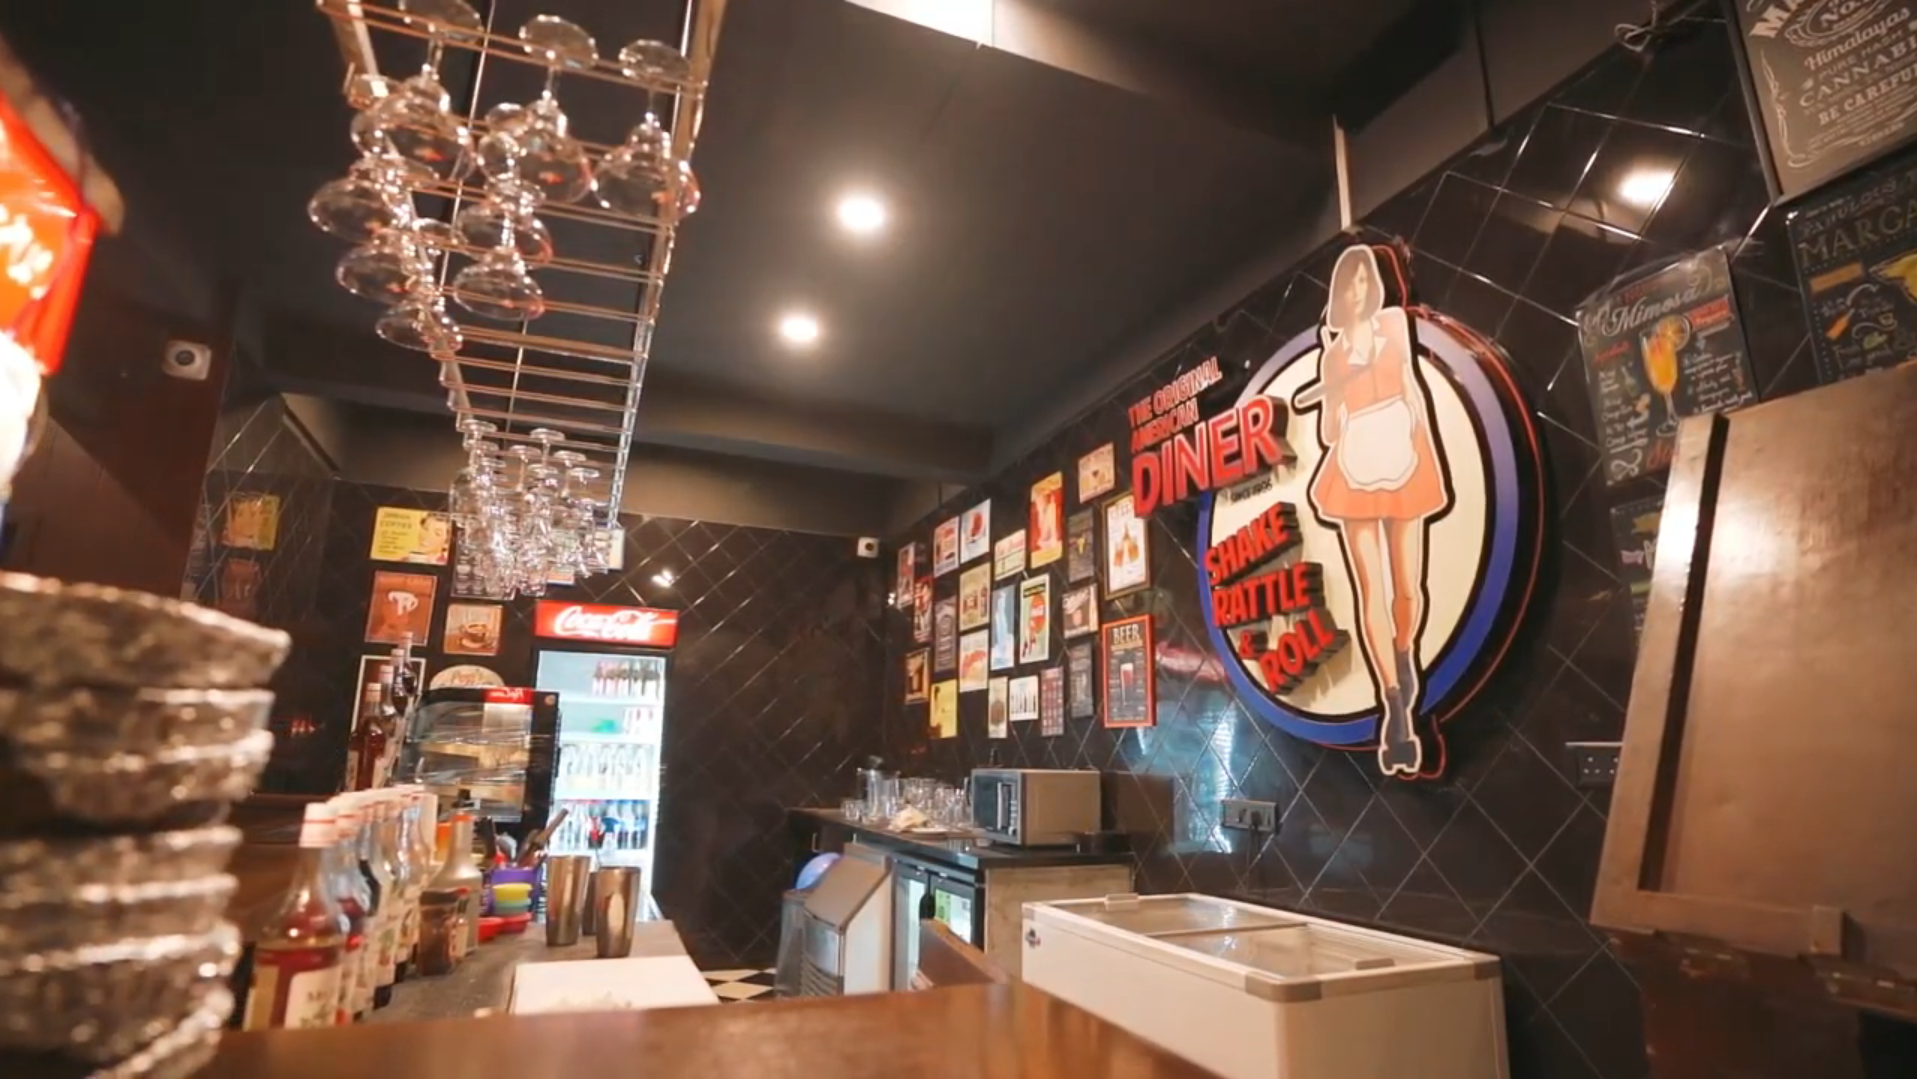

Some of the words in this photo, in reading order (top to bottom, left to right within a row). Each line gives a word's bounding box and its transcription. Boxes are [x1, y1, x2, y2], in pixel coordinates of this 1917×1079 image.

[1804, 7, 1910, 71] Himalayas
[1818, 106, 1841, 126] BE
[1601, 285, 1702, 337] Mimosa
[1128, 396, 1153, 429] THE
[1153, 356, 1223, 415] ORIGINAL
[1131, 397, 1199, 453] AMERICAN
[1132, 393, 1282, 519] DINER
[1204, 501, 1290, 586] SHAKE
[554, 604, 672, 642] Coca-Cola
[1211, 561, 1311, 628] RATTLE
[1112, 622, 1141, 646] BEER
[1239, 629, 1255, 660] &
[1260, 608, 1335, 694] ROLL
